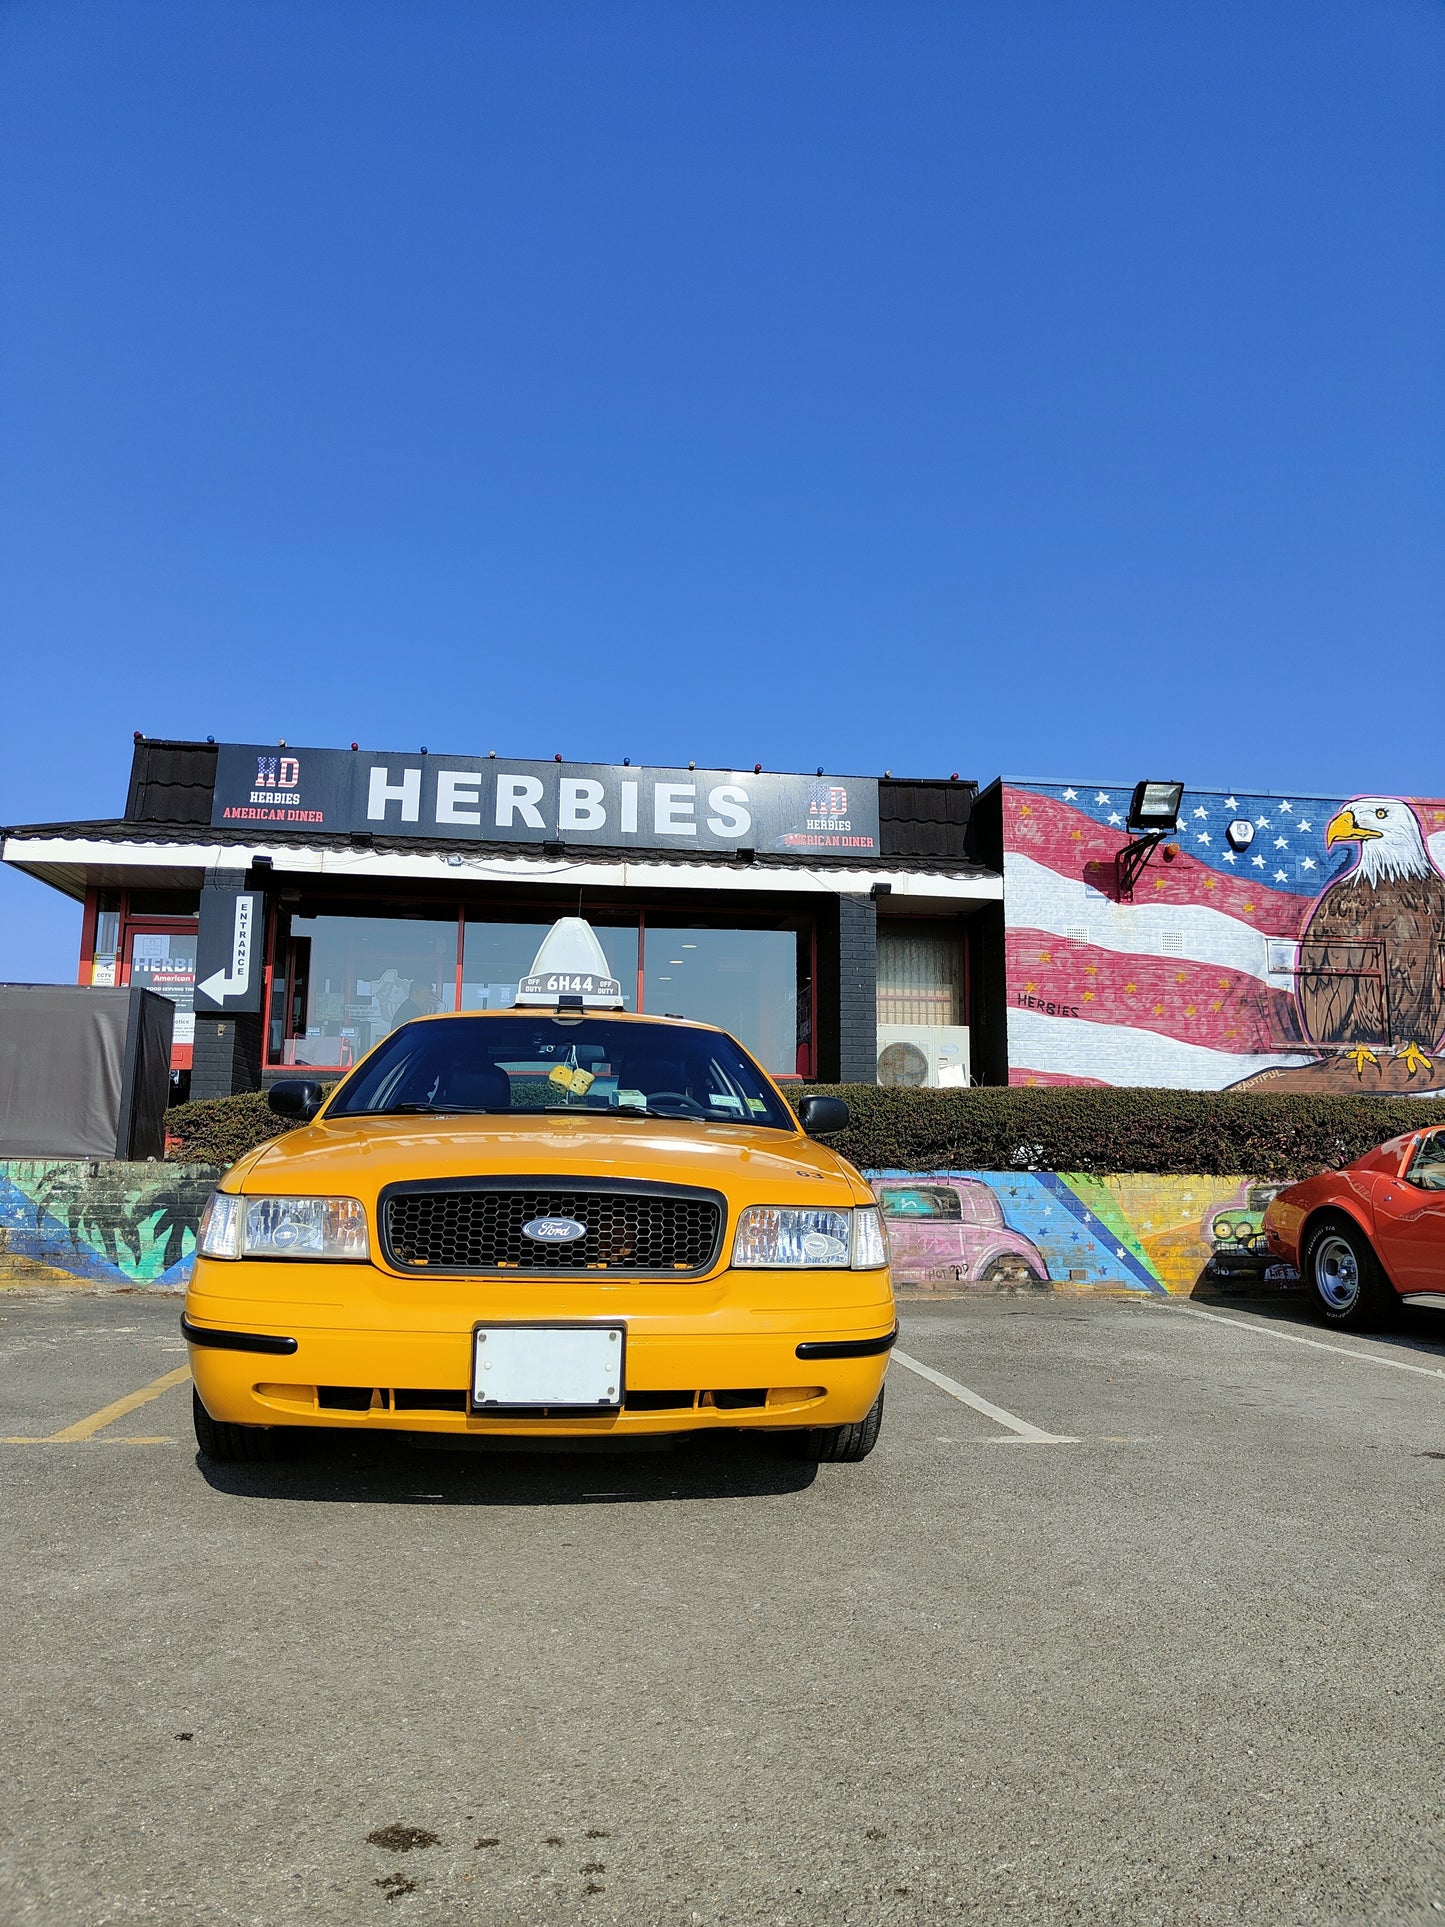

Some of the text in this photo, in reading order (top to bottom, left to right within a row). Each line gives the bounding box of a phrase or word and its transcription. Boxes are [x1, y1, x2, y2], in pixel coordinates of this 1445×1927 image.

[255, 757, 299, 787] HD
[249, 792, 300, 805] HERBIES
[367, 767, 752, 838] HERBIES
[809, 785, 848, 815] HD
[223, 807, 323, 823] AMERICAN DINER
[806, 819, 851, 831] HERBIES
[784, 833, 874, 848] AMERICAN DINER
[237, 903, 248, 976] ENTRANCE
[154, 974, 190, 982] American
[547, 975, 593, 992] 6H44
[525, 985, 542, 993] DUTY
[1017, 993, 1079, 1018] HERBIES
[538, 1221, 570, 1236] Ford
